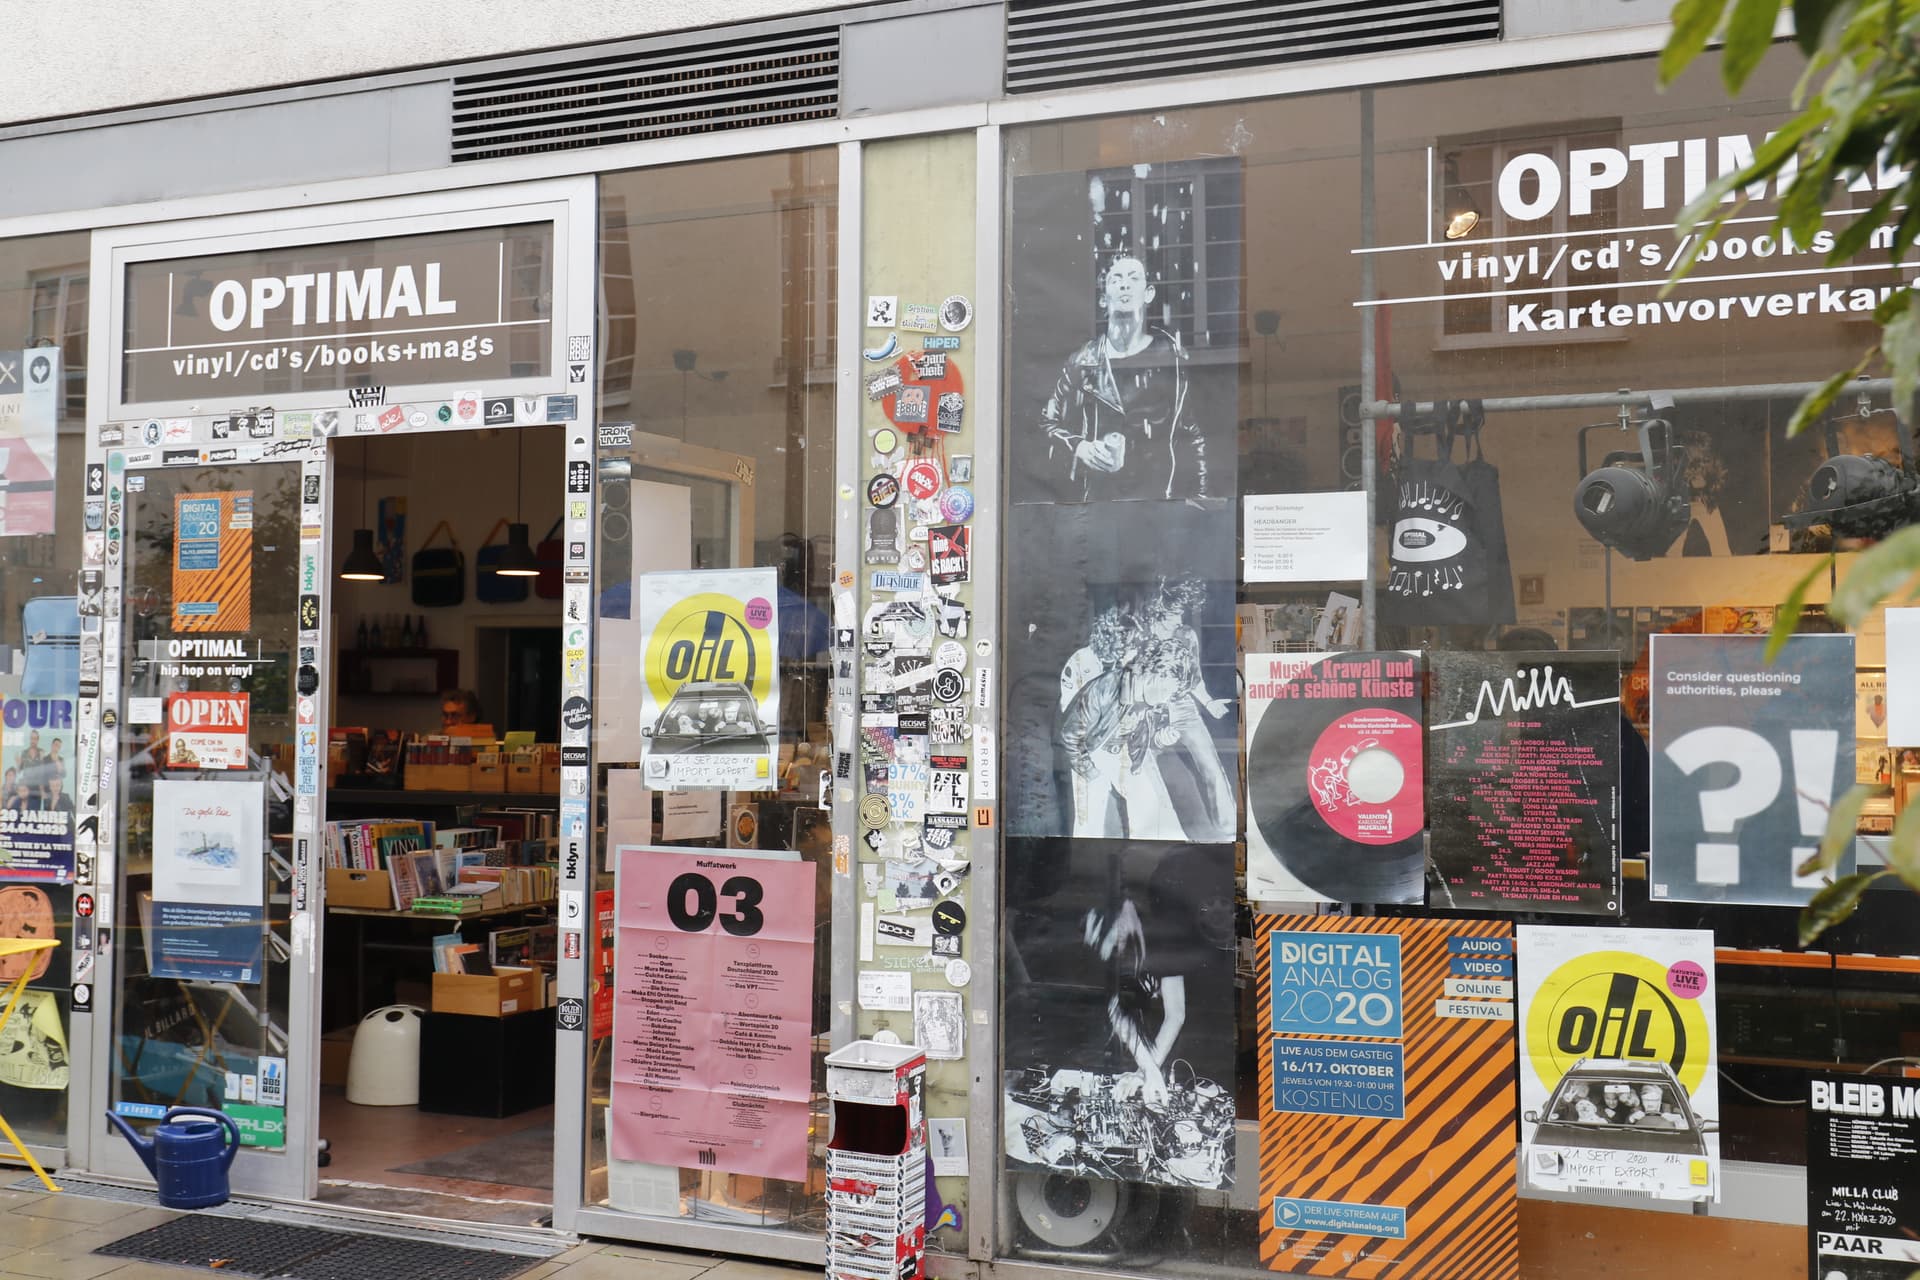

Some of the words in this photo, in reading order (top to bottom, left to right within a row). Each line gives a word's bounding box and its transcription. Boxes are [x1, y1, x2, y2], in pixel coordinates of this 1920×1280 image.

[209, 263, 457, 332] OPTIMAL
[172, 335, 495, 379] vinyl/cd's/books+mags
[183, 503, 217, 514] DIGITAL
[182, 522, 218, 536] 2020
[304, 555, 314, 591] bklyn
[750, 609, 767, 618] LIVE
[168, 639, 247, 658] OPTIMAL
[161, 664, 179, 678] hip
[182, 665, 204, 678] hop
[207, 667, 222, 677] on
[225, 663, 253, 678] vinyl
[1270, 660, 1319, 682] Musik,
[1322, 659, 1381, 679] Krawall
[1386, 658, 1414, 678] und
[1666, 671, 1723, 683] Consider
[1726, 672, 1801, 684] questioning
[1249, 681, 1299, 699] andere
[1304, 680, 1356, 699] schöne
[1361, 679, 1414, 699] Künste
[1666, 684, 1737, 697] authorities,
[1740, 685, 1782, 697] please
[0, 698, 73, 730] OUR
[172, 698, 246, 727] OPEN
[900, 720, 927, 729] DECISIVE
[81, 730, 98, 794] CHILDHOOD
[563, 752, 587, 760] DECISIVE
[21, 810, 68, 825] JAHRE
[567, 842, 579, 880] bklyn
[696, 860, 737, 870] Muffatwerk
[667, 872, 764, 937] 03
[1461, 940, 1502, 952] AUDIO
[1281, 942, 1391, 968] DIGITAL
[1463, 962, 1502, 974] VIDEO
[1282, 966, 1393, 990] ANALOG
[1675, 975, 1699, 986] LIVE
[1455, 983, 1502, 996] ONLINE
[1280, 989, 1394, 1027] 2020
[1448, 1004, 1503, 1017] FESTIVAL
[1281, 1046, 1301, 1056] LIVE
[1303, 1048, 1324, 1057] AUS
[1325, 1048, 1348, 1059] DEM
[1350, 1050, 1393, 1061] GASTEIG
[1281, 1060, 1328, 1074] 16./17.
[1330, 1063, 1394, 1078] OKTOBER
[1281, 1077, 1310, 1087] JEWEILS
[1311, 1079, 1332, 1088] VON
[1378, 1083, 1395, 1091] UHR
[1282, 1089, 1394, 1112] KOSTENLOS
[1811, 1079, 1885, 1117] BLEIB
[1627, 1152, 1648, 1165] 2020
[1566, 1163, 1605, 1176] IMPORT
[1614, 1166, 1658, 1178] EXPORT
[1832, 1186, 1869, 1199] MILLA
[1872, 1185, 1899, 1201] CLUB
[1304, 1206, 1322, 1216] DER
[1380, 1211, 1400, 1222] AUF
[1304, 1217, 1400, 1234] www.digitalanalog.org
[1818, 1234, 1883, 1254] PAAR
